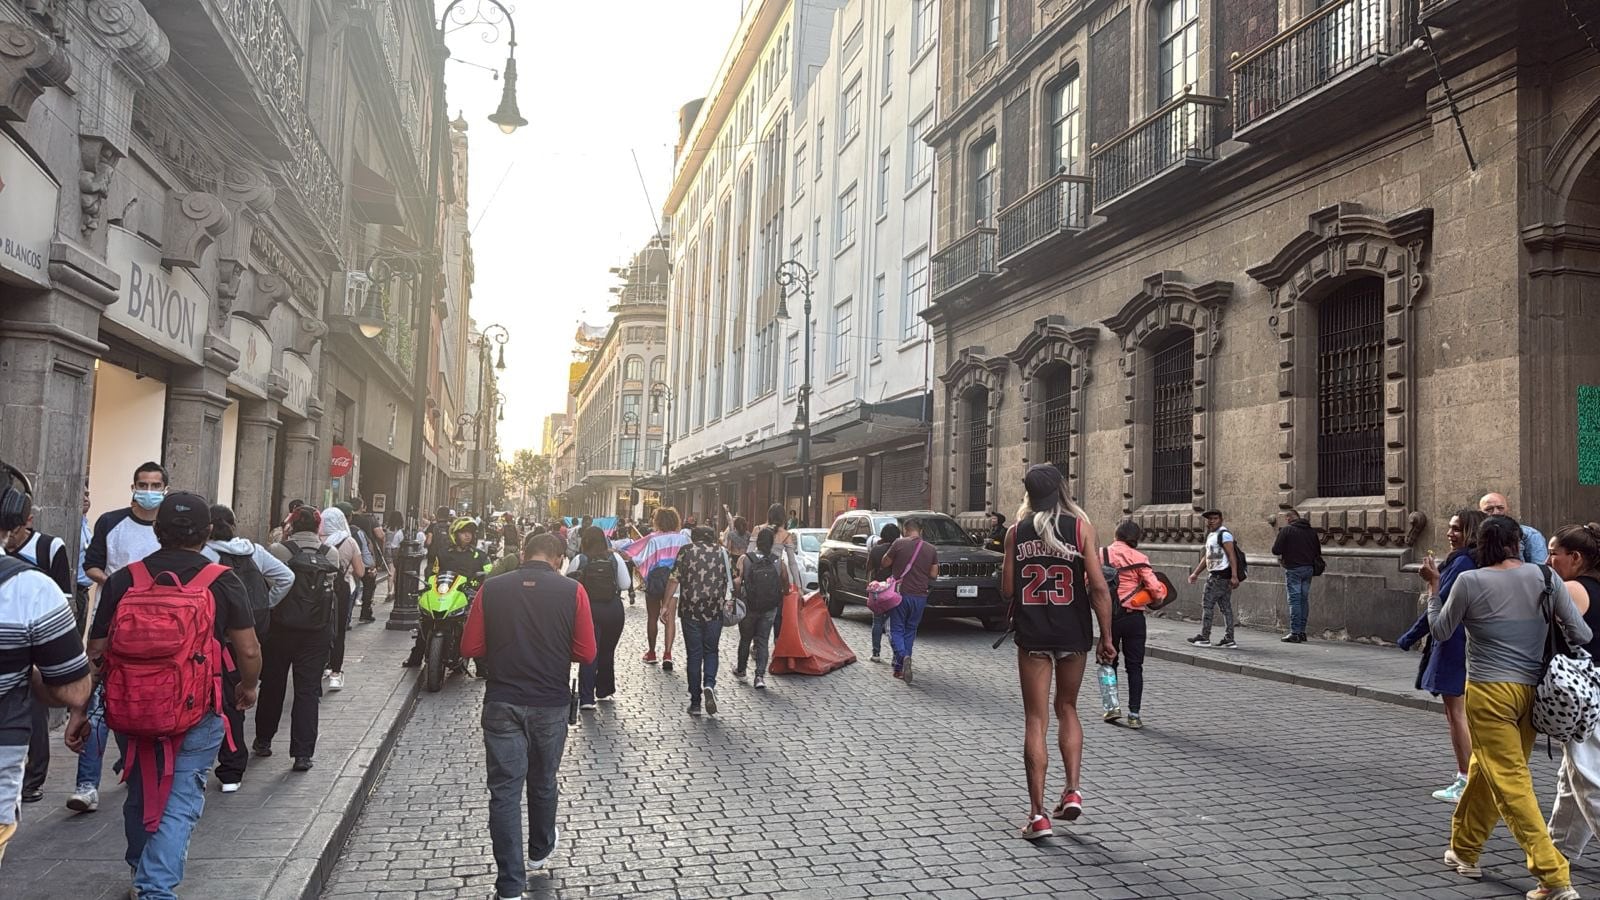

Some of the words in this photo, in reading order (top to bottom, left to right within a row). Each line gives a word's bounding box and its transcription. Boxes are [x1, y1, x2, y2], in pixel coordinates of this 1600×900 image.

[5, 238, 42, 270] BLANCOS
[127, 260, 197, 349] BAYON
[1021, 563, 1075, 606] 23
